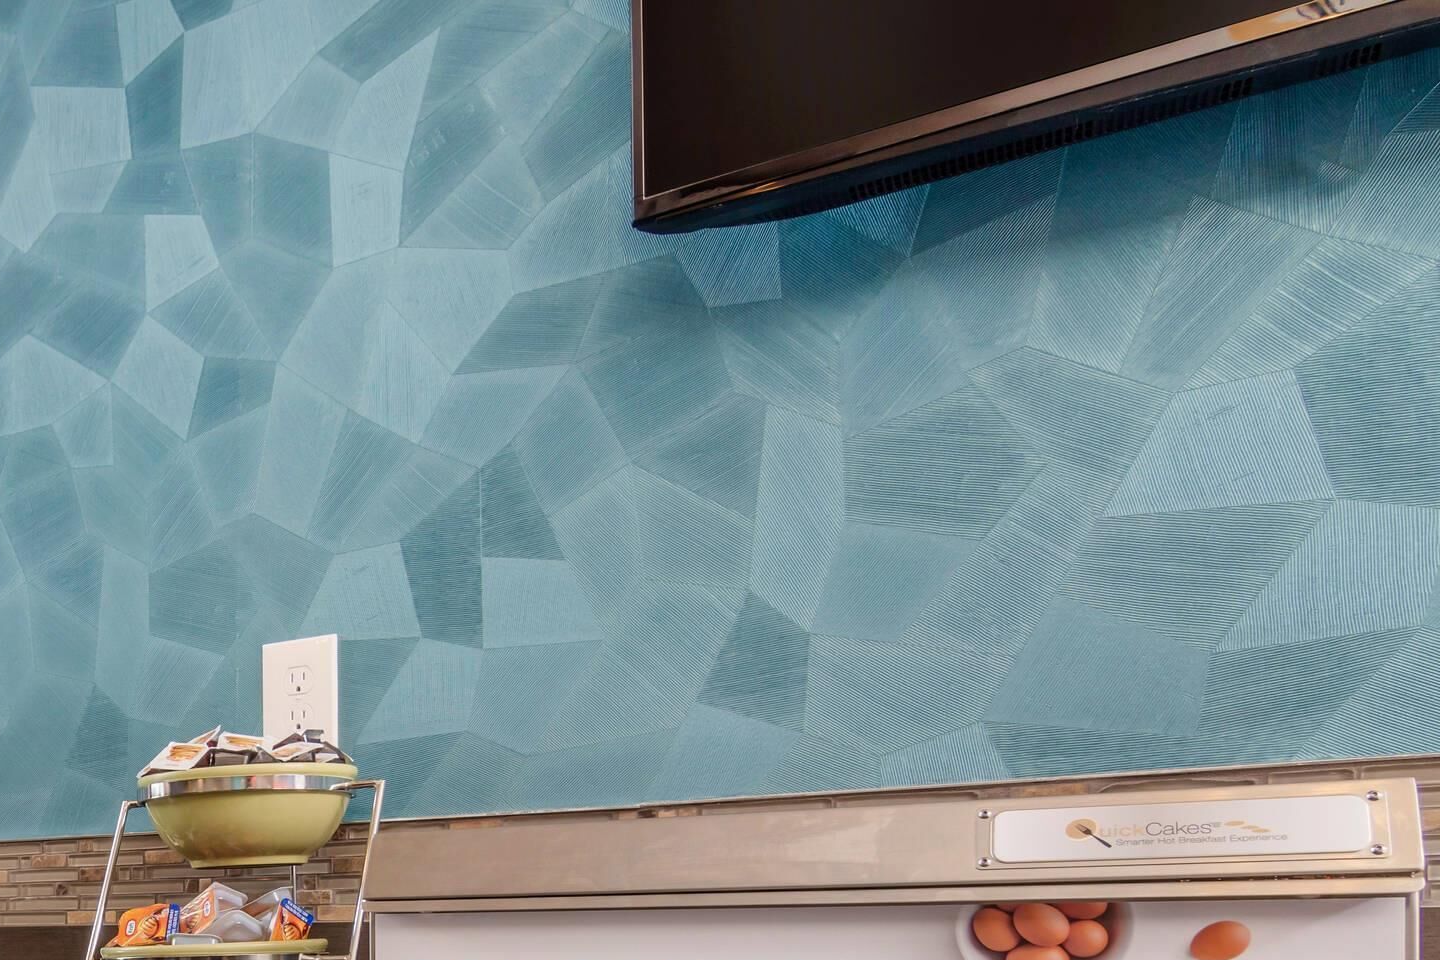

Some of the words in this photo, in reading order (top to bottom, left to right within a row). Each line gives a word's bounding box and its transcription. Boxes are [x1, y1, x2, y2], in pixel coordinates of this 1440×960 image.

[1115, 838, 1154, 847] Smarter
[1159, 837, 1176, 845] Hot
[1179, 835, 1226, 844] Breakfast
[1229, 833, 1288, 843] Experience
